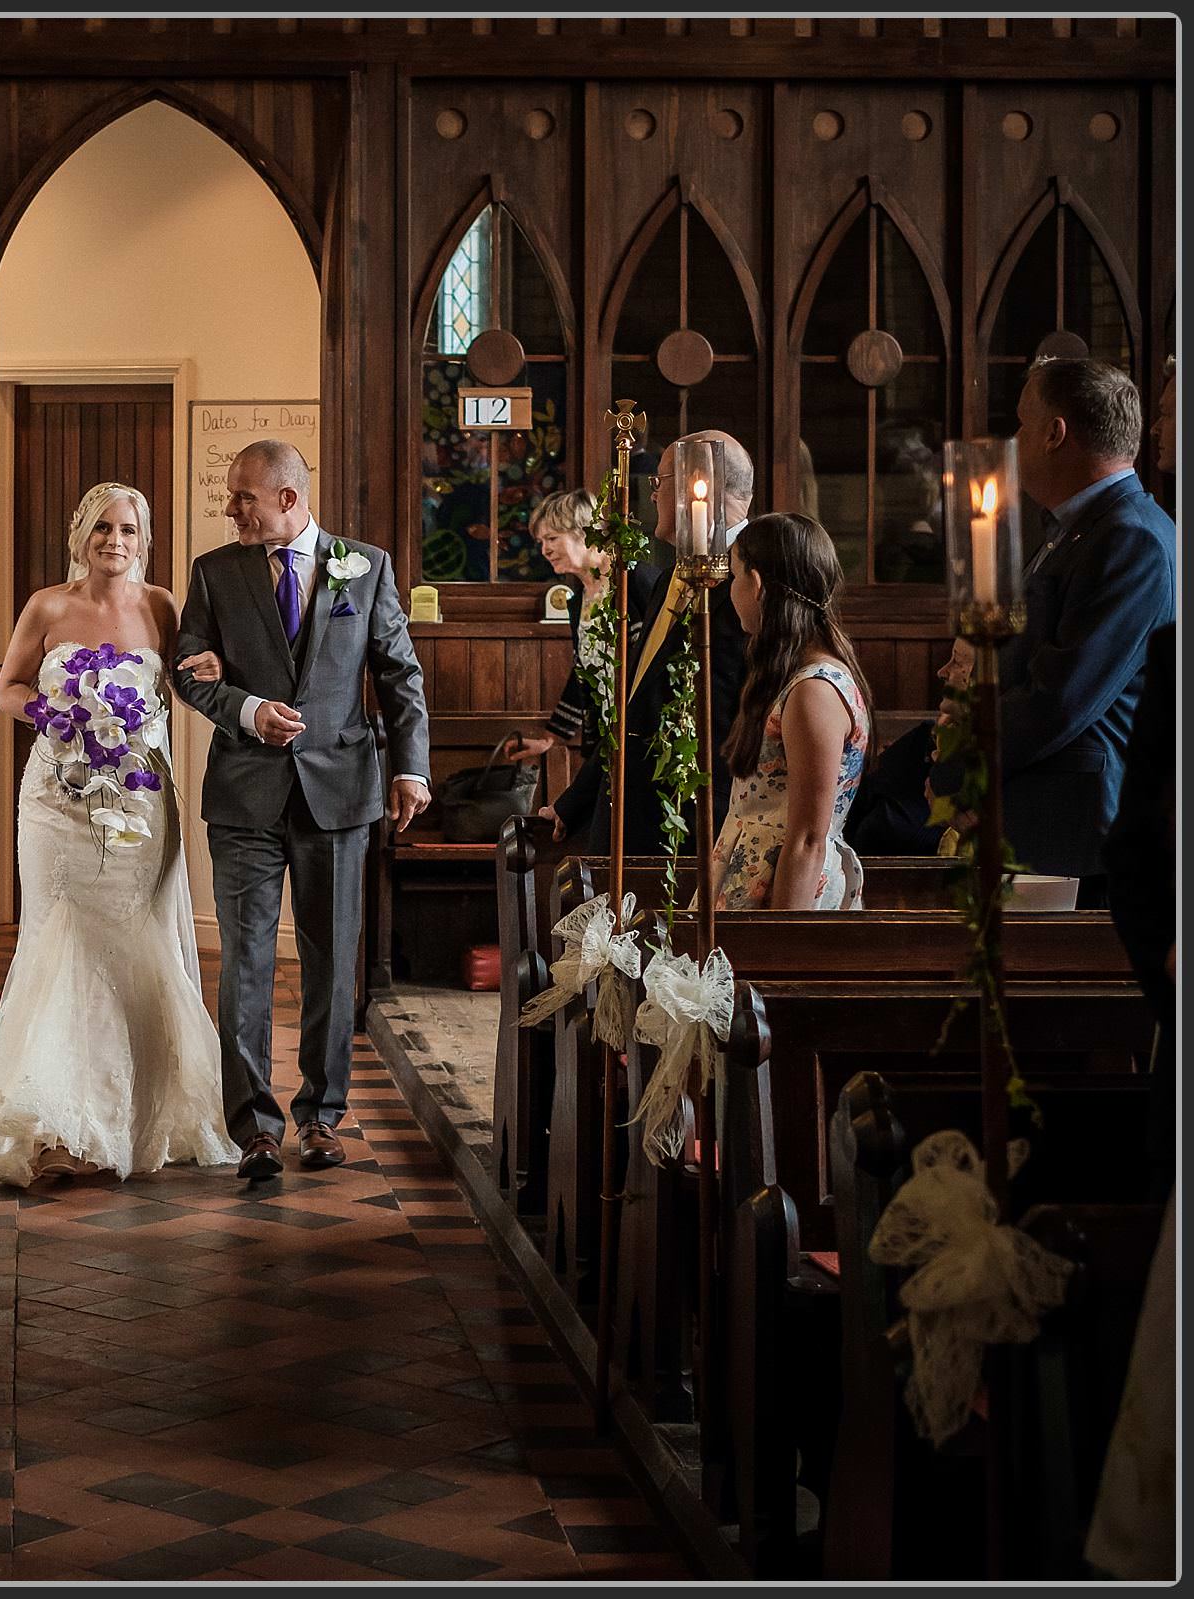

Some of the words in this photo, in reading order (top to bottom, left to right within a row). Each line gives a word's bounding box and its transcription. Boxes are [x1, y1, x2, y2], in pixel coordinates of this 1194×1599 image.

[202, 410, 238, 431] Dates
[248, 408, 269, 431] for
[280, 408, 316, 438] Diary
[471, 398, 508, 424] 12
